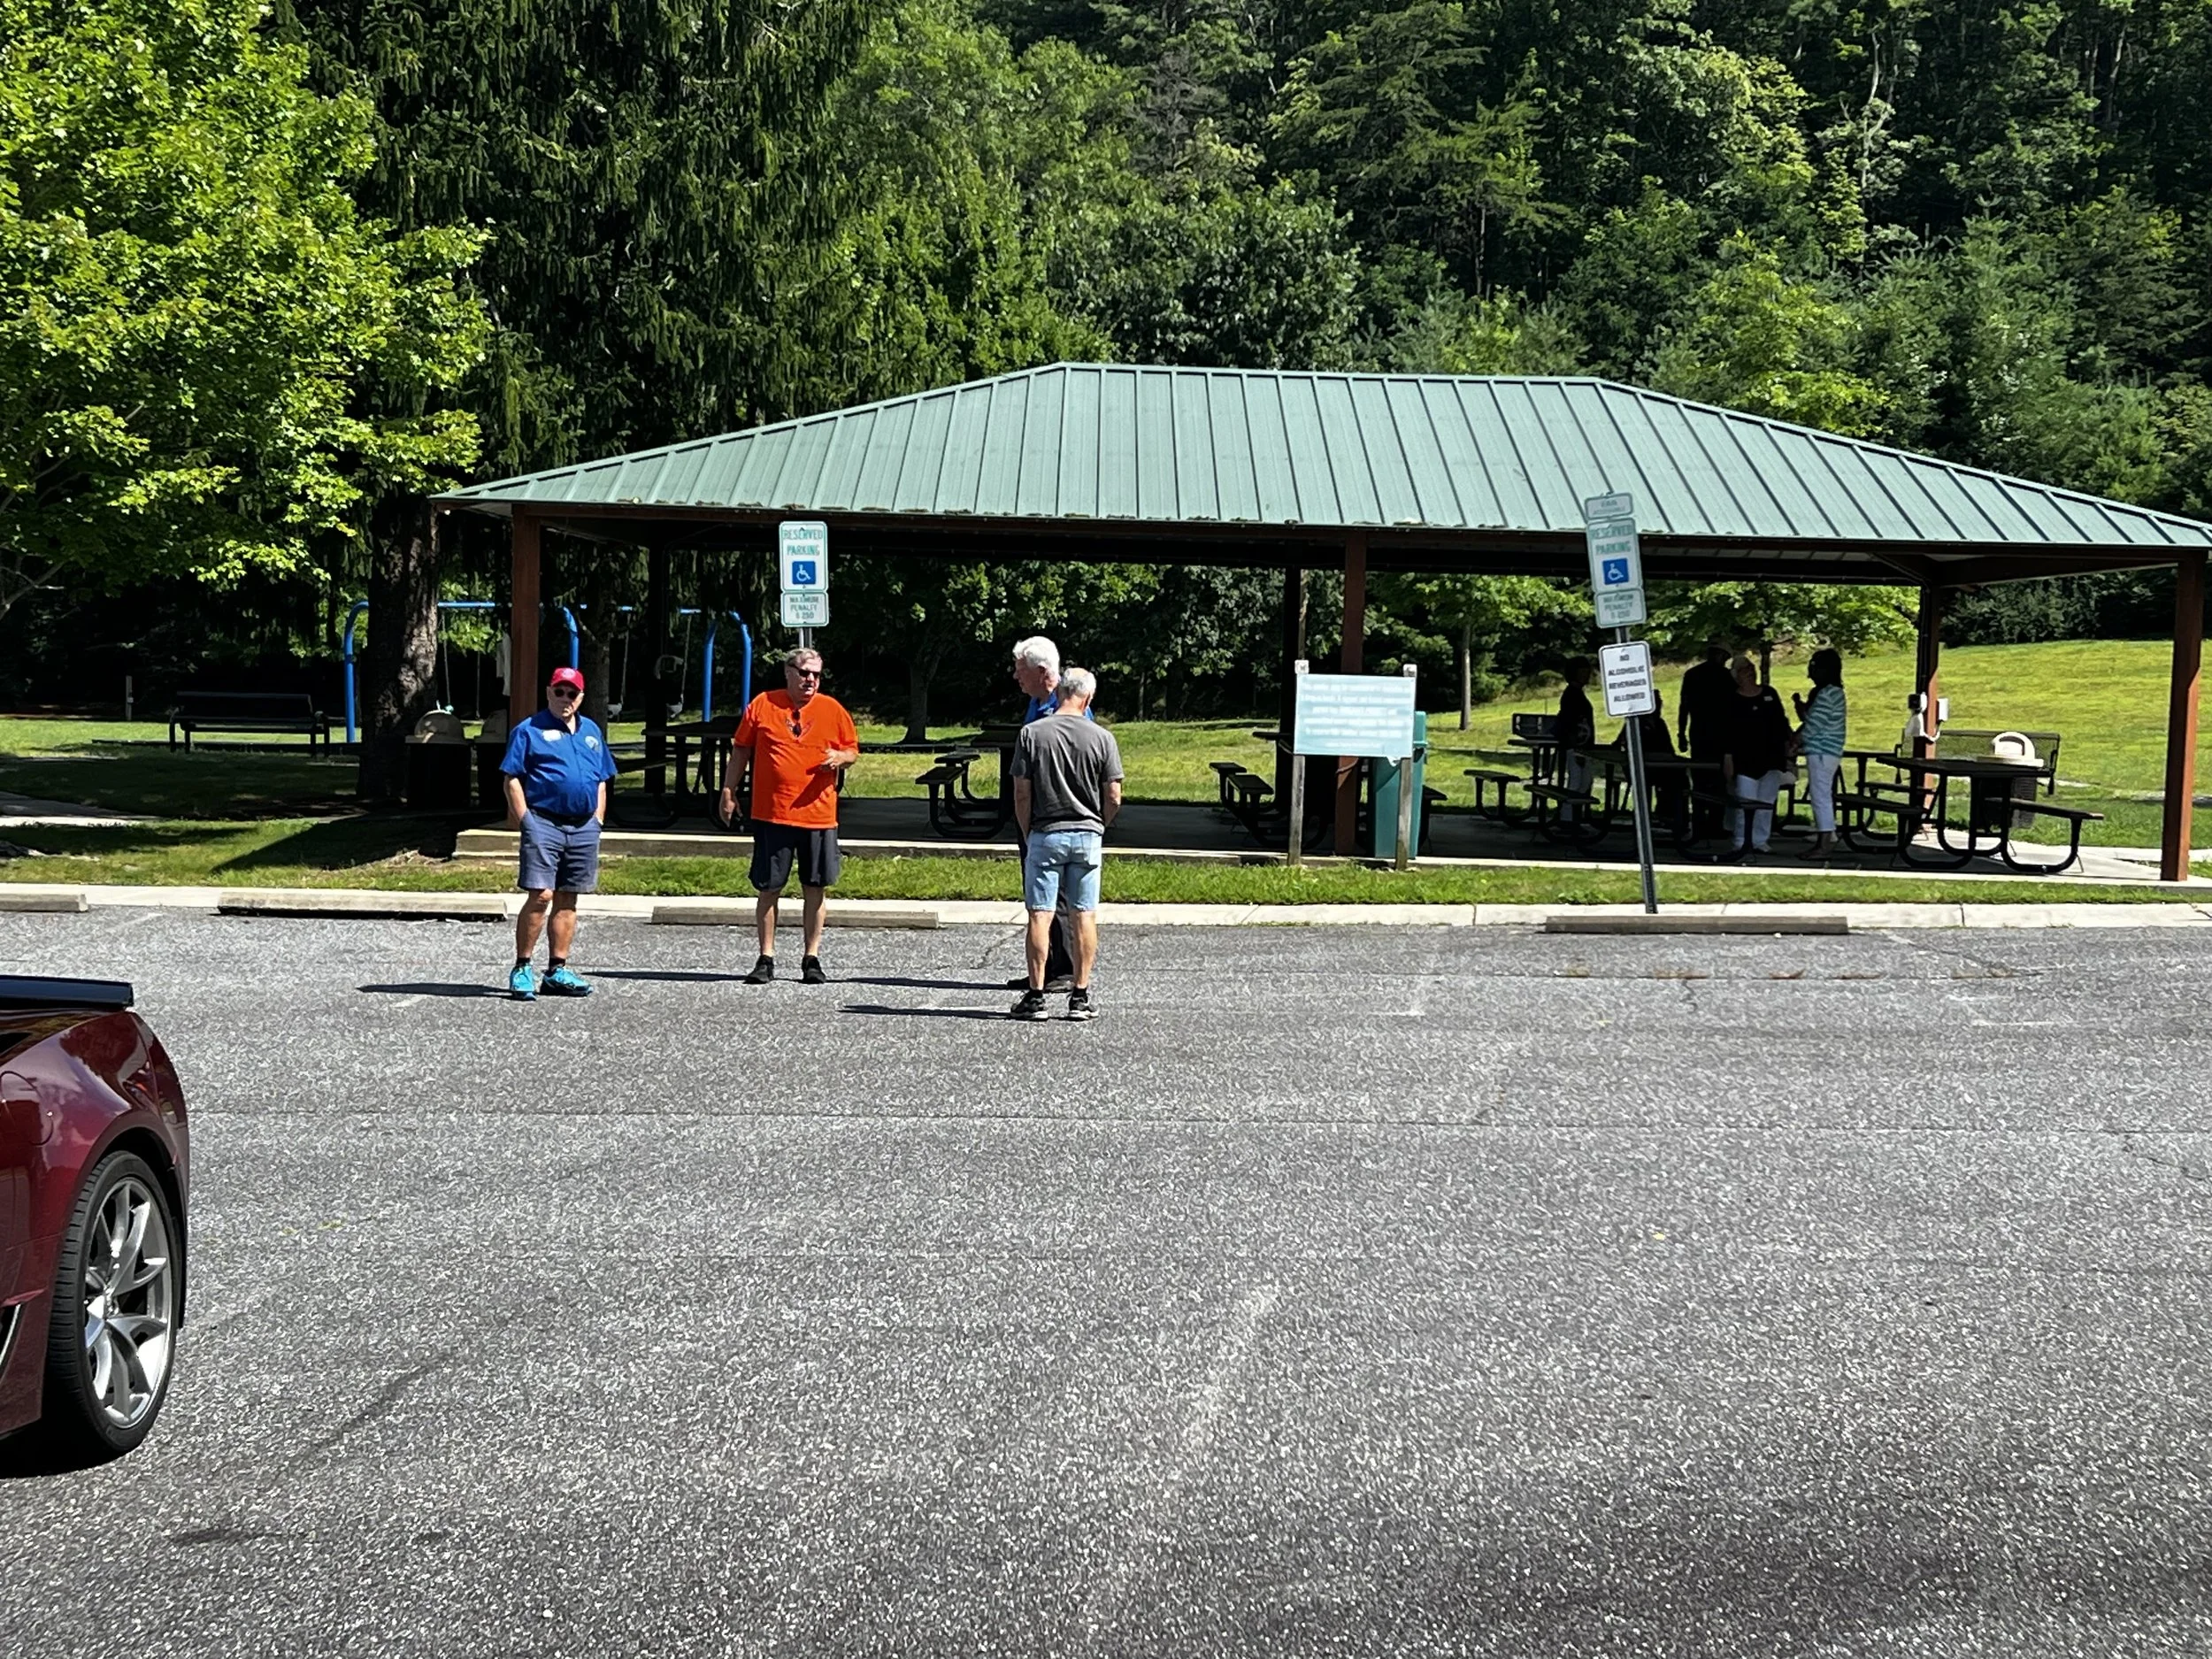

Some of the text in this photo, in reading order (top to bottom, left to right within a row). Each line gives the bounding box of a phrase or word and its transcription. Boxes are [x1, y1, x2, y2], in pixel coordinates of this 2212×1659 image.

[783, 529, 823, 540] RESERVED
[787, 544, 820, 556] PARKING
[1595, 541, 1632, 555] PARKING
[1614, 692, 1645, 702] ALLOWED
